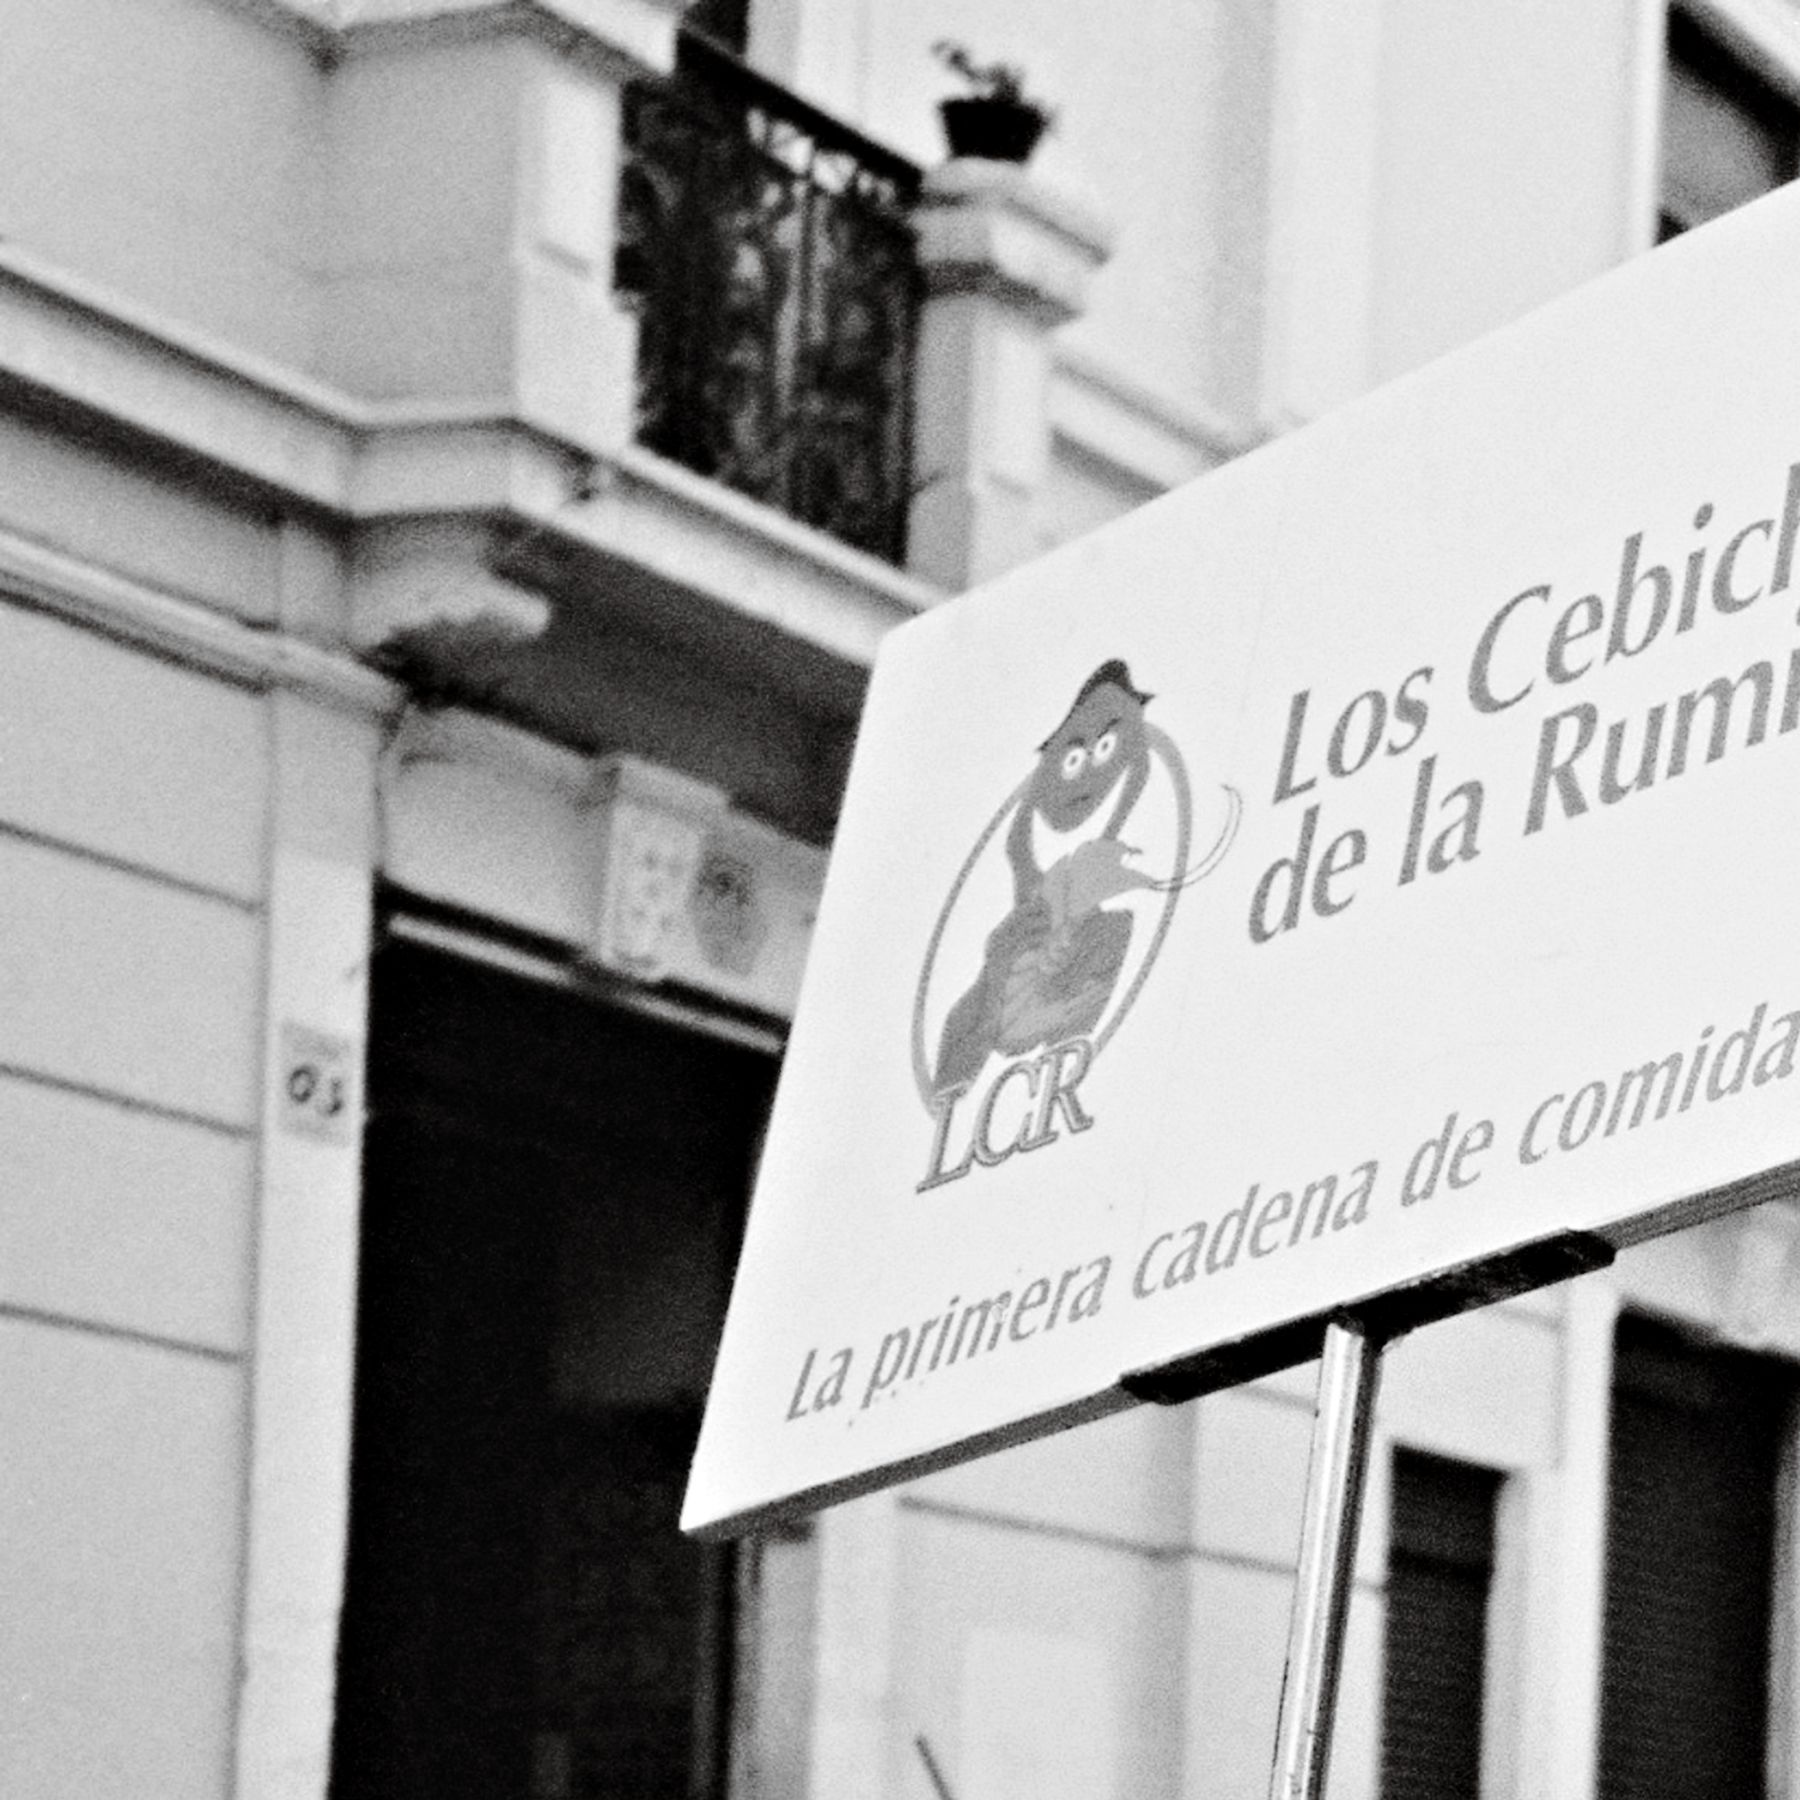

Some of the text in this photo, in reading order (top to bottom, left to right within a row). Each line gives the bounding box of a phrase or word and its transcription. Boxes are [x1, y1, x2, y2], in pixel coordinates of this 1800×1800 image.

[1272, 665, 1434, 804] Los
[1247, 803, 1367, 944] de
[1397, 754, 1486, 886] la
[916, 1037, 1094, 1194] LCR
[786, 1347, 854, 1421] La
[861, 1254, 1112, 1408] primera
[1133, 1160, 1379, 1298] cadena
[1400, 1112, 1494, 1207] de
